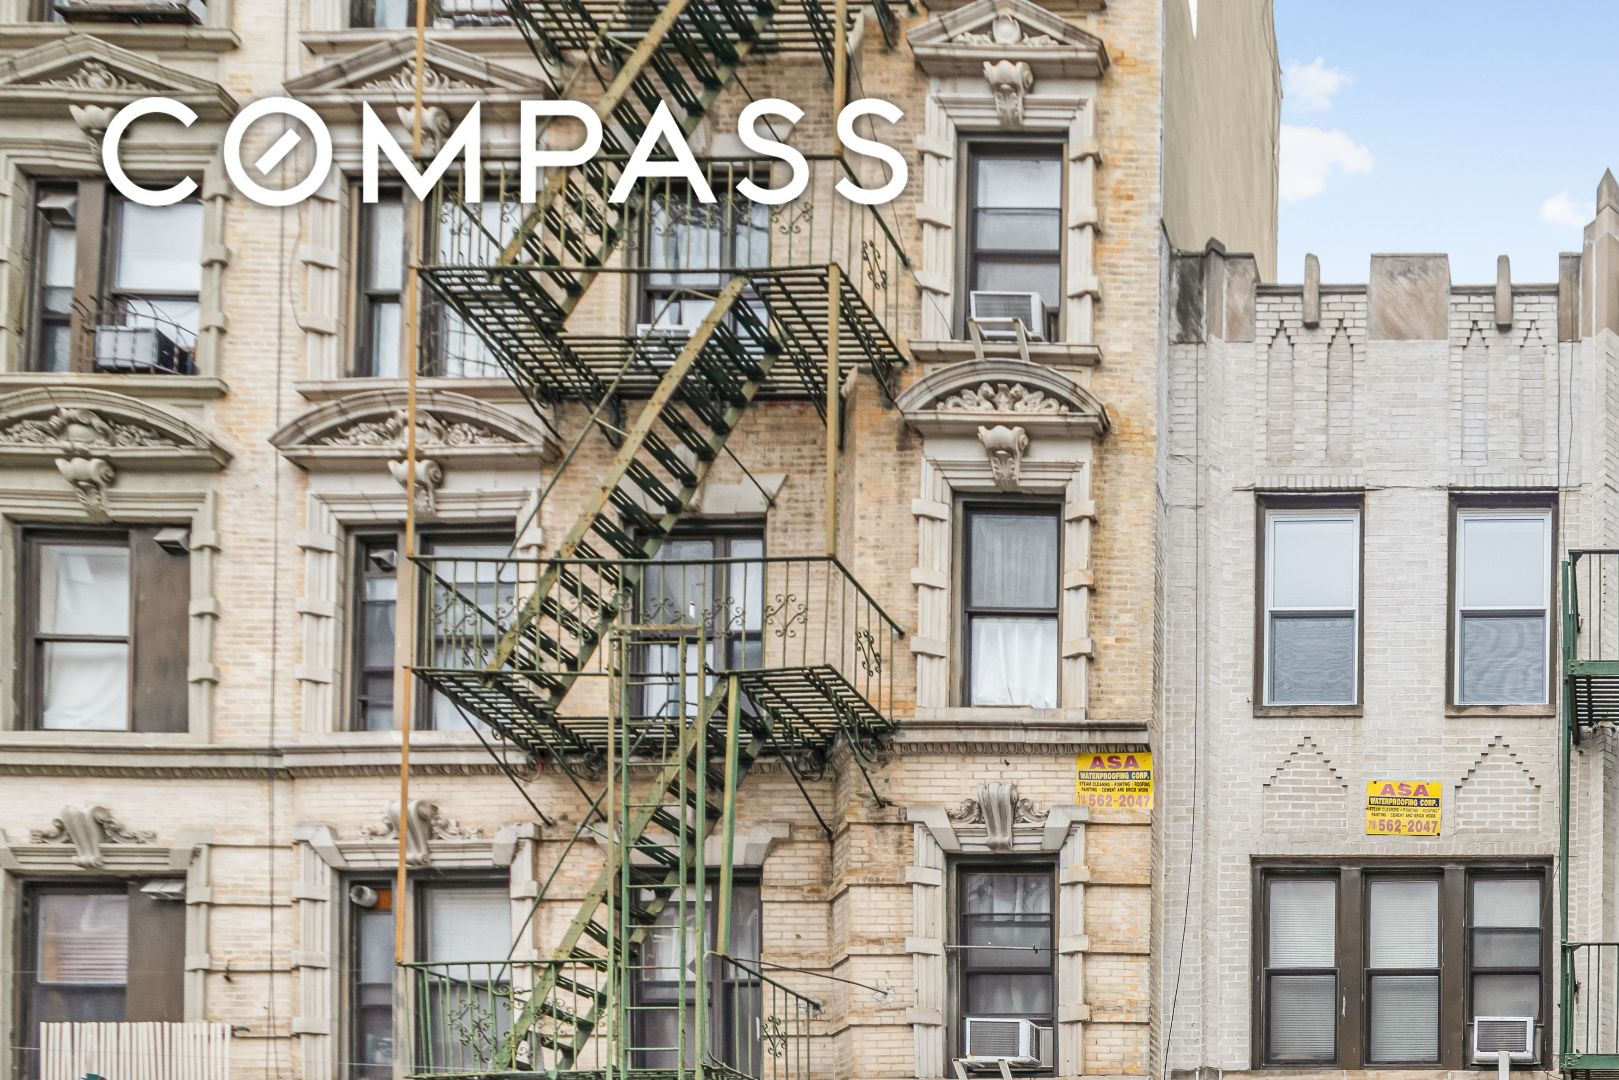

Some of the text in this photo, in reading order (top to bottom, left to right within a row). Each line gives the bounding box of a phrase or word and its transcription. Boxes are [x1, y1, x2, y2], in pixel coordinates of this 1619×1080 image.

[1090, 755, 1140, 769] ASA
[1080, 772, 1150, 780] WATERPROOFING CORP.
[1380, 784, 1429, 796] ASA
[1089, 794, 1150, 807] 562-2047
[1370, 798, 1438, 807] WATERPROOFING CORP.
[1379, 819, 1438, 833] 562-2047
